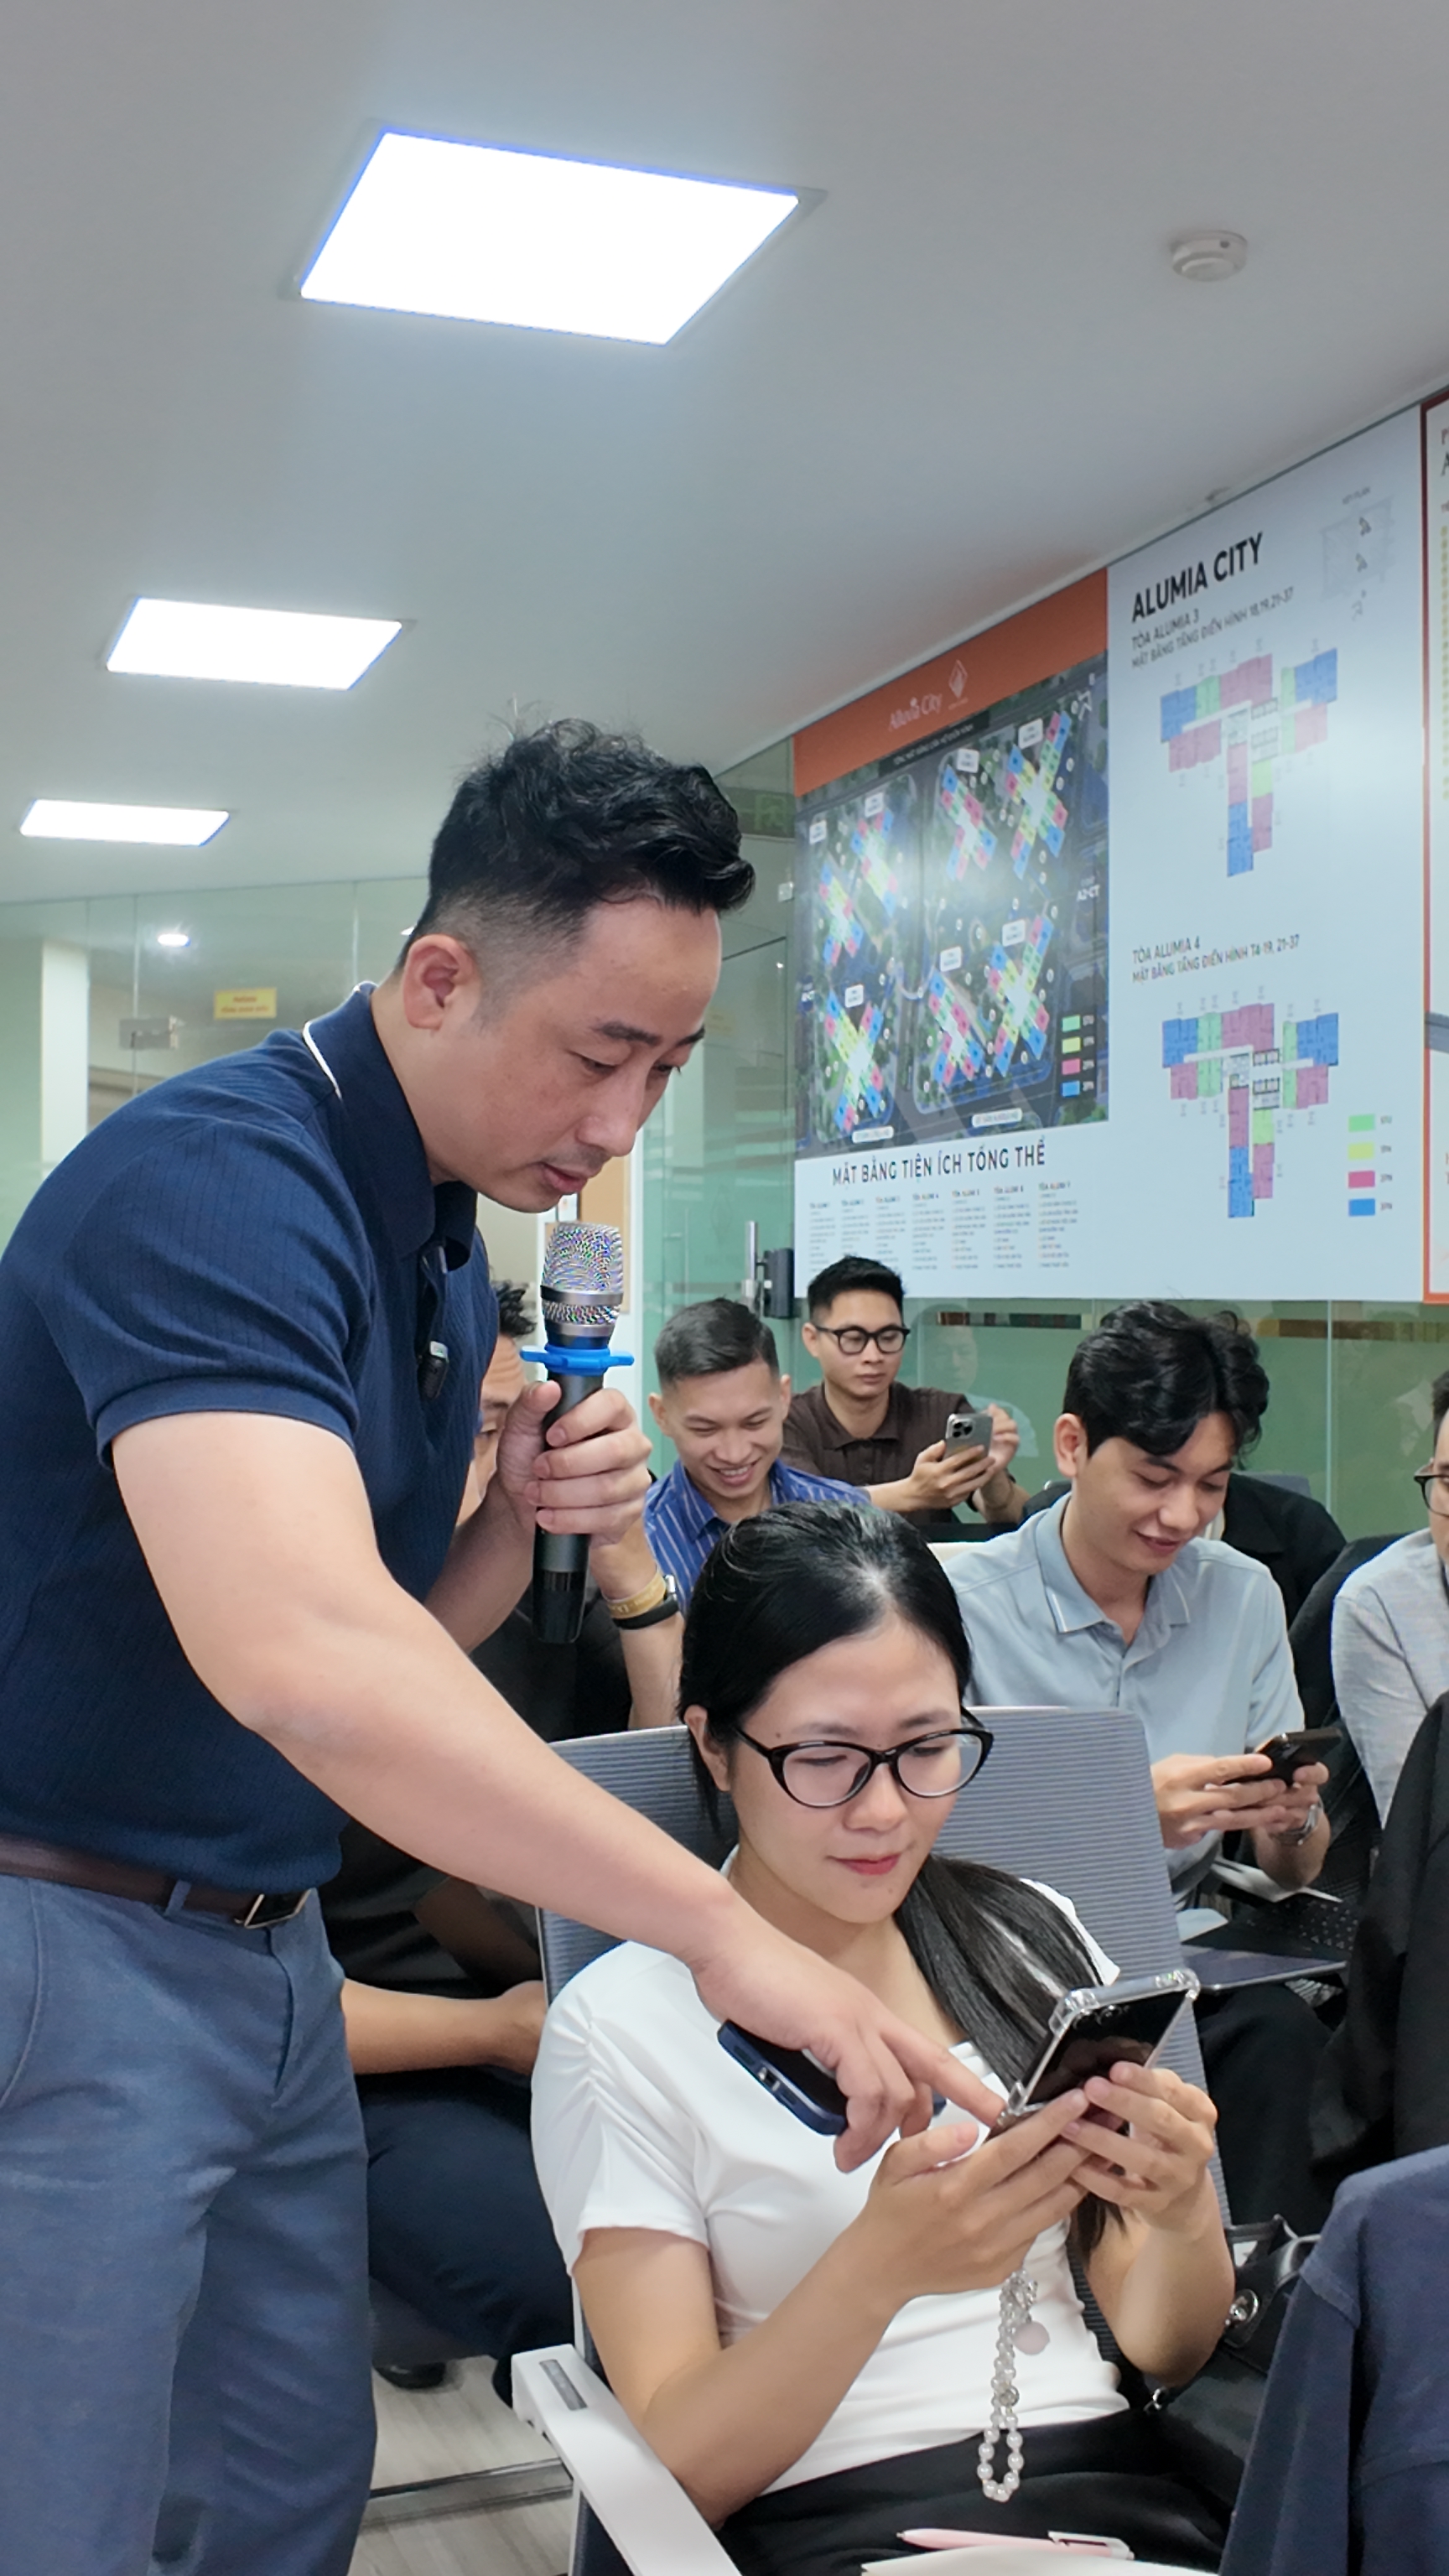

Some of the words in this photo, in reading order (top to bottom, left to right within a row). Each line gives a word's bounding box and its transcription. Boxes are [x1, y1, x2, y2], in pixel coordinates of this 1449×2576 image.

[1132, 561, 1208, 623] ALUMIA
[1213, 531, 1263, 582] CITY
[1153, 613, 1191, 641] ALUMIA
[1193, 608, 1199, 624] 3
[1132, 946, 1152, 964] TÒA
[1154, 937, 1192, 959] ALUMIA
[1194, 935, 1200, 950] 4
[833, 1161, 857, 1190] MẶT
[861, 1156, 897, 1183] BẰNG
[902, 1152, 932, 1183] TIỆN
[937, 1150, 962, 1176] ÍCH
[967, 1143, 1009, 1172] TỔNG
[1015, 1135, 1046, 1168] THỂ
